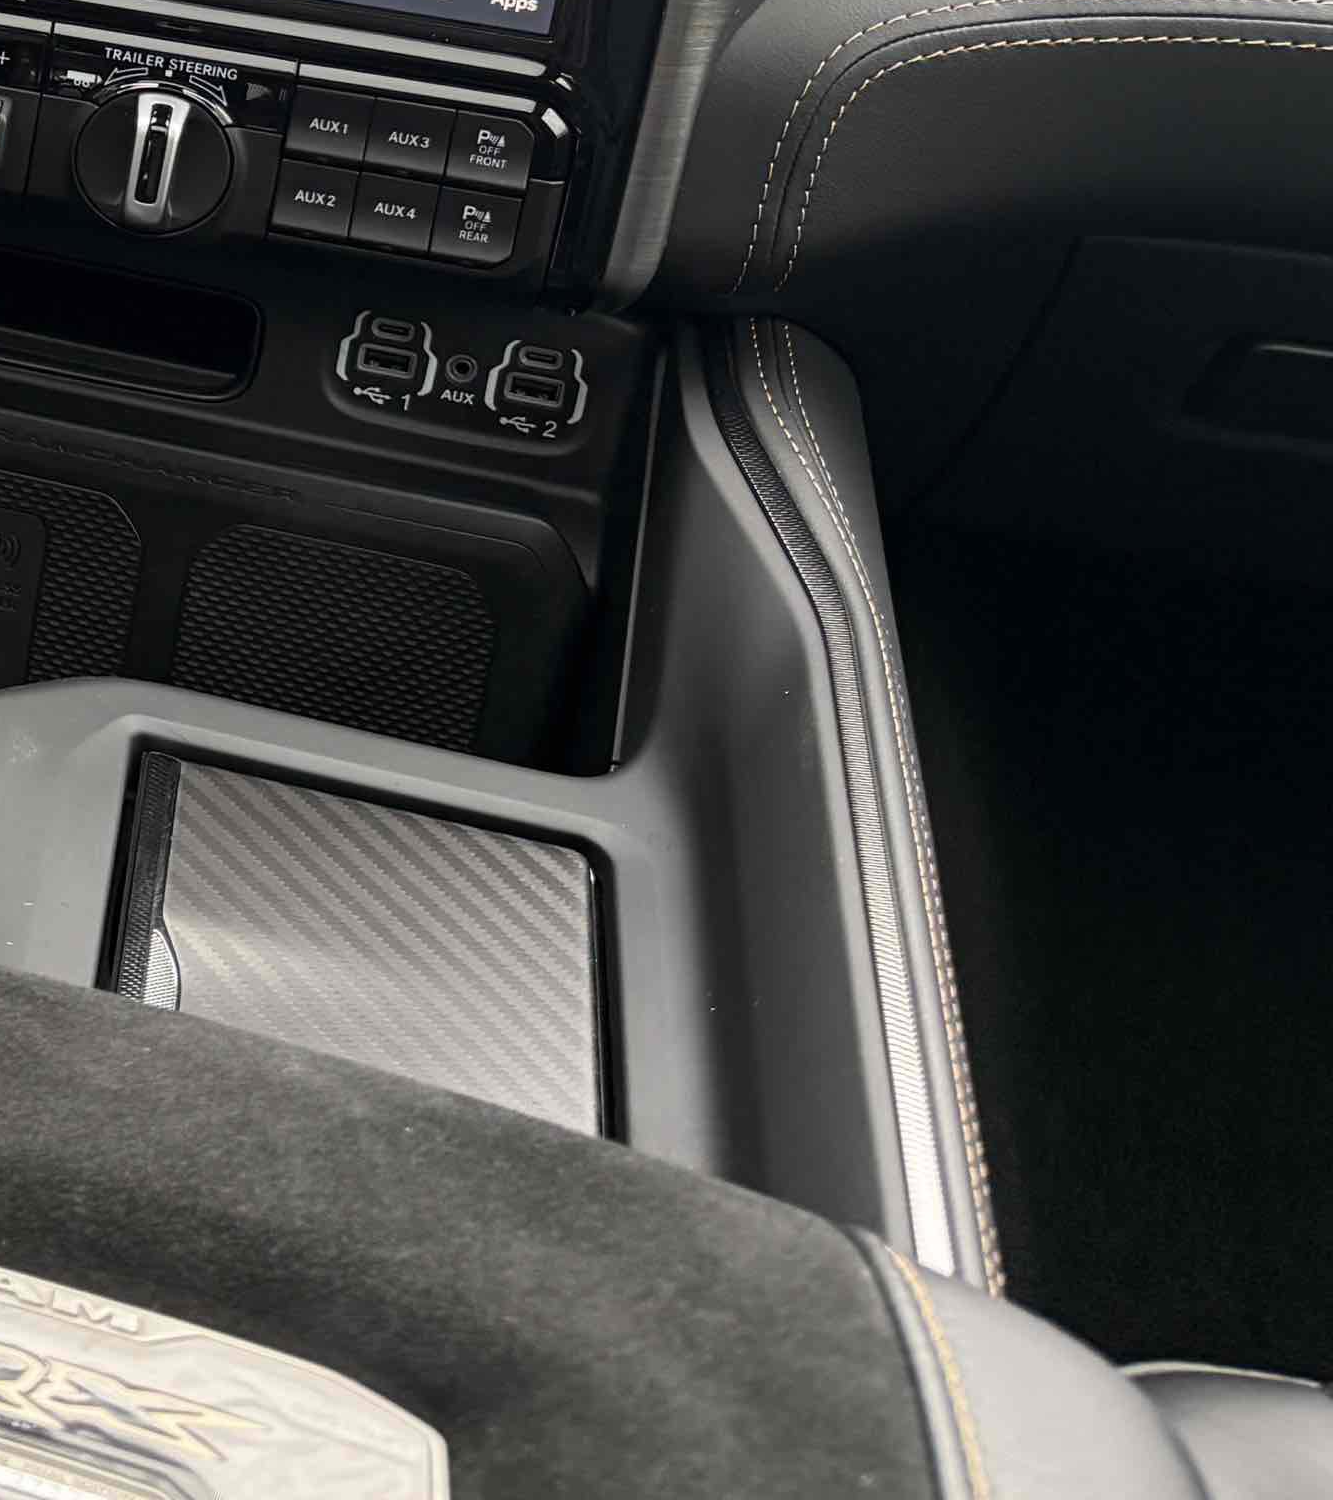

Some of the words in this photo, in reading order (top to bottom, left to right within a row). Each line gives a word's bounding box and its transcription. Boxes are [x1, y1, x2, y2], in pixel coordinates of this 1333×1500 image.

[103, 46, 166, 69] TRAILER
[167, 57, 239, 82] STEERING
[308, 116, 343, 134] AUX
[387, 130, 421, 148] AUX
[420, 136, 431, 149] 3
[478, 144, 502, 157] OFF
[468, 153, 509, 170] FRONT
[293, 188, 327, 206] AUX
[325, 194, 337, 208] 2
[373, 201, 406, 218] AUX
[405, 206, 417, 220] 4
[463, 219, 487, 232] OFF
[457, 229, 490, 244] REAR
[400, 392, 412, 412] 1
[439, 388, 476, 406] AUX
[541, 419, 559, 439] 2
